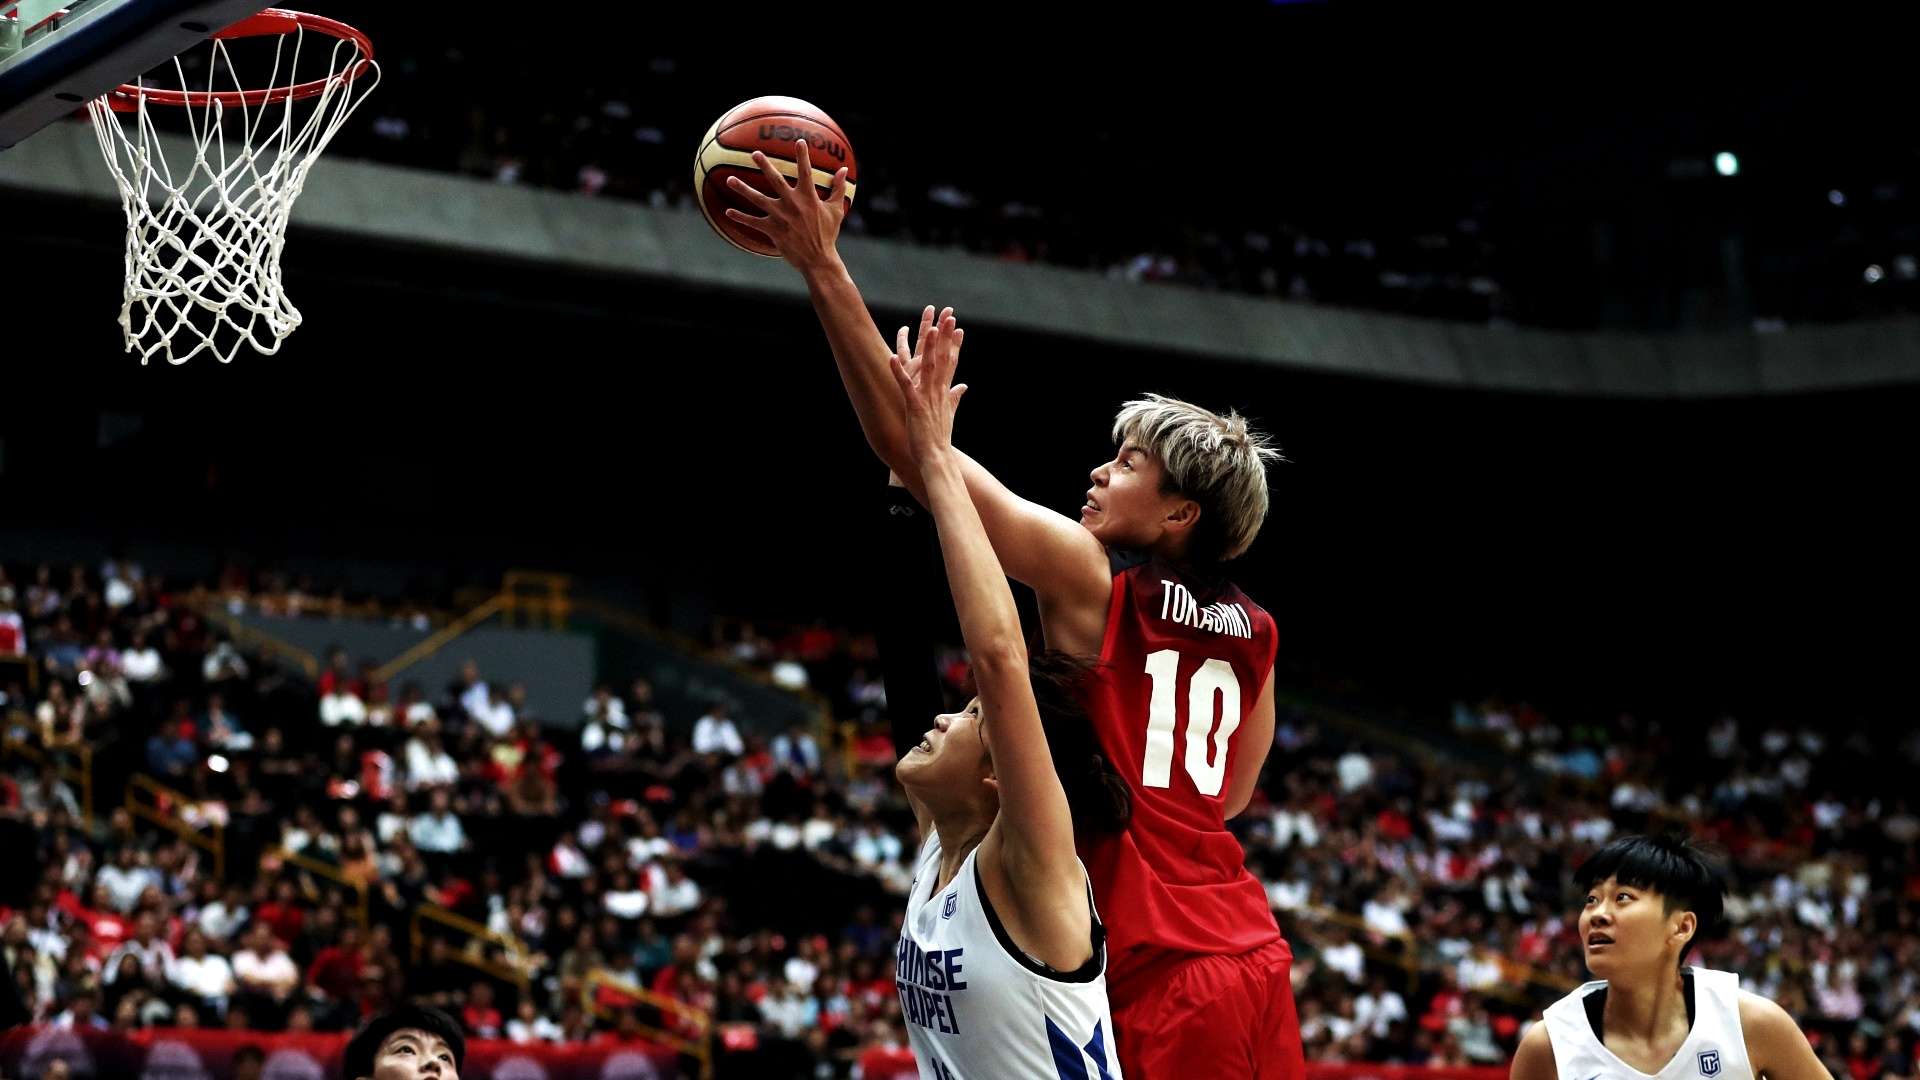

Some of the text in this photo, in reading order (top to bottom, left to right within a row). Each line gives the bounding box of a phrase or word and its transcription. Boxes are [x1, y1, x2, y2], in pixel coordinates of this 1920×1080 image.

[1142, 648, 1241, 796] 10
[896, 936, 967, 991] HINESE
[896, 980, 960, 1034] TAIPEI
